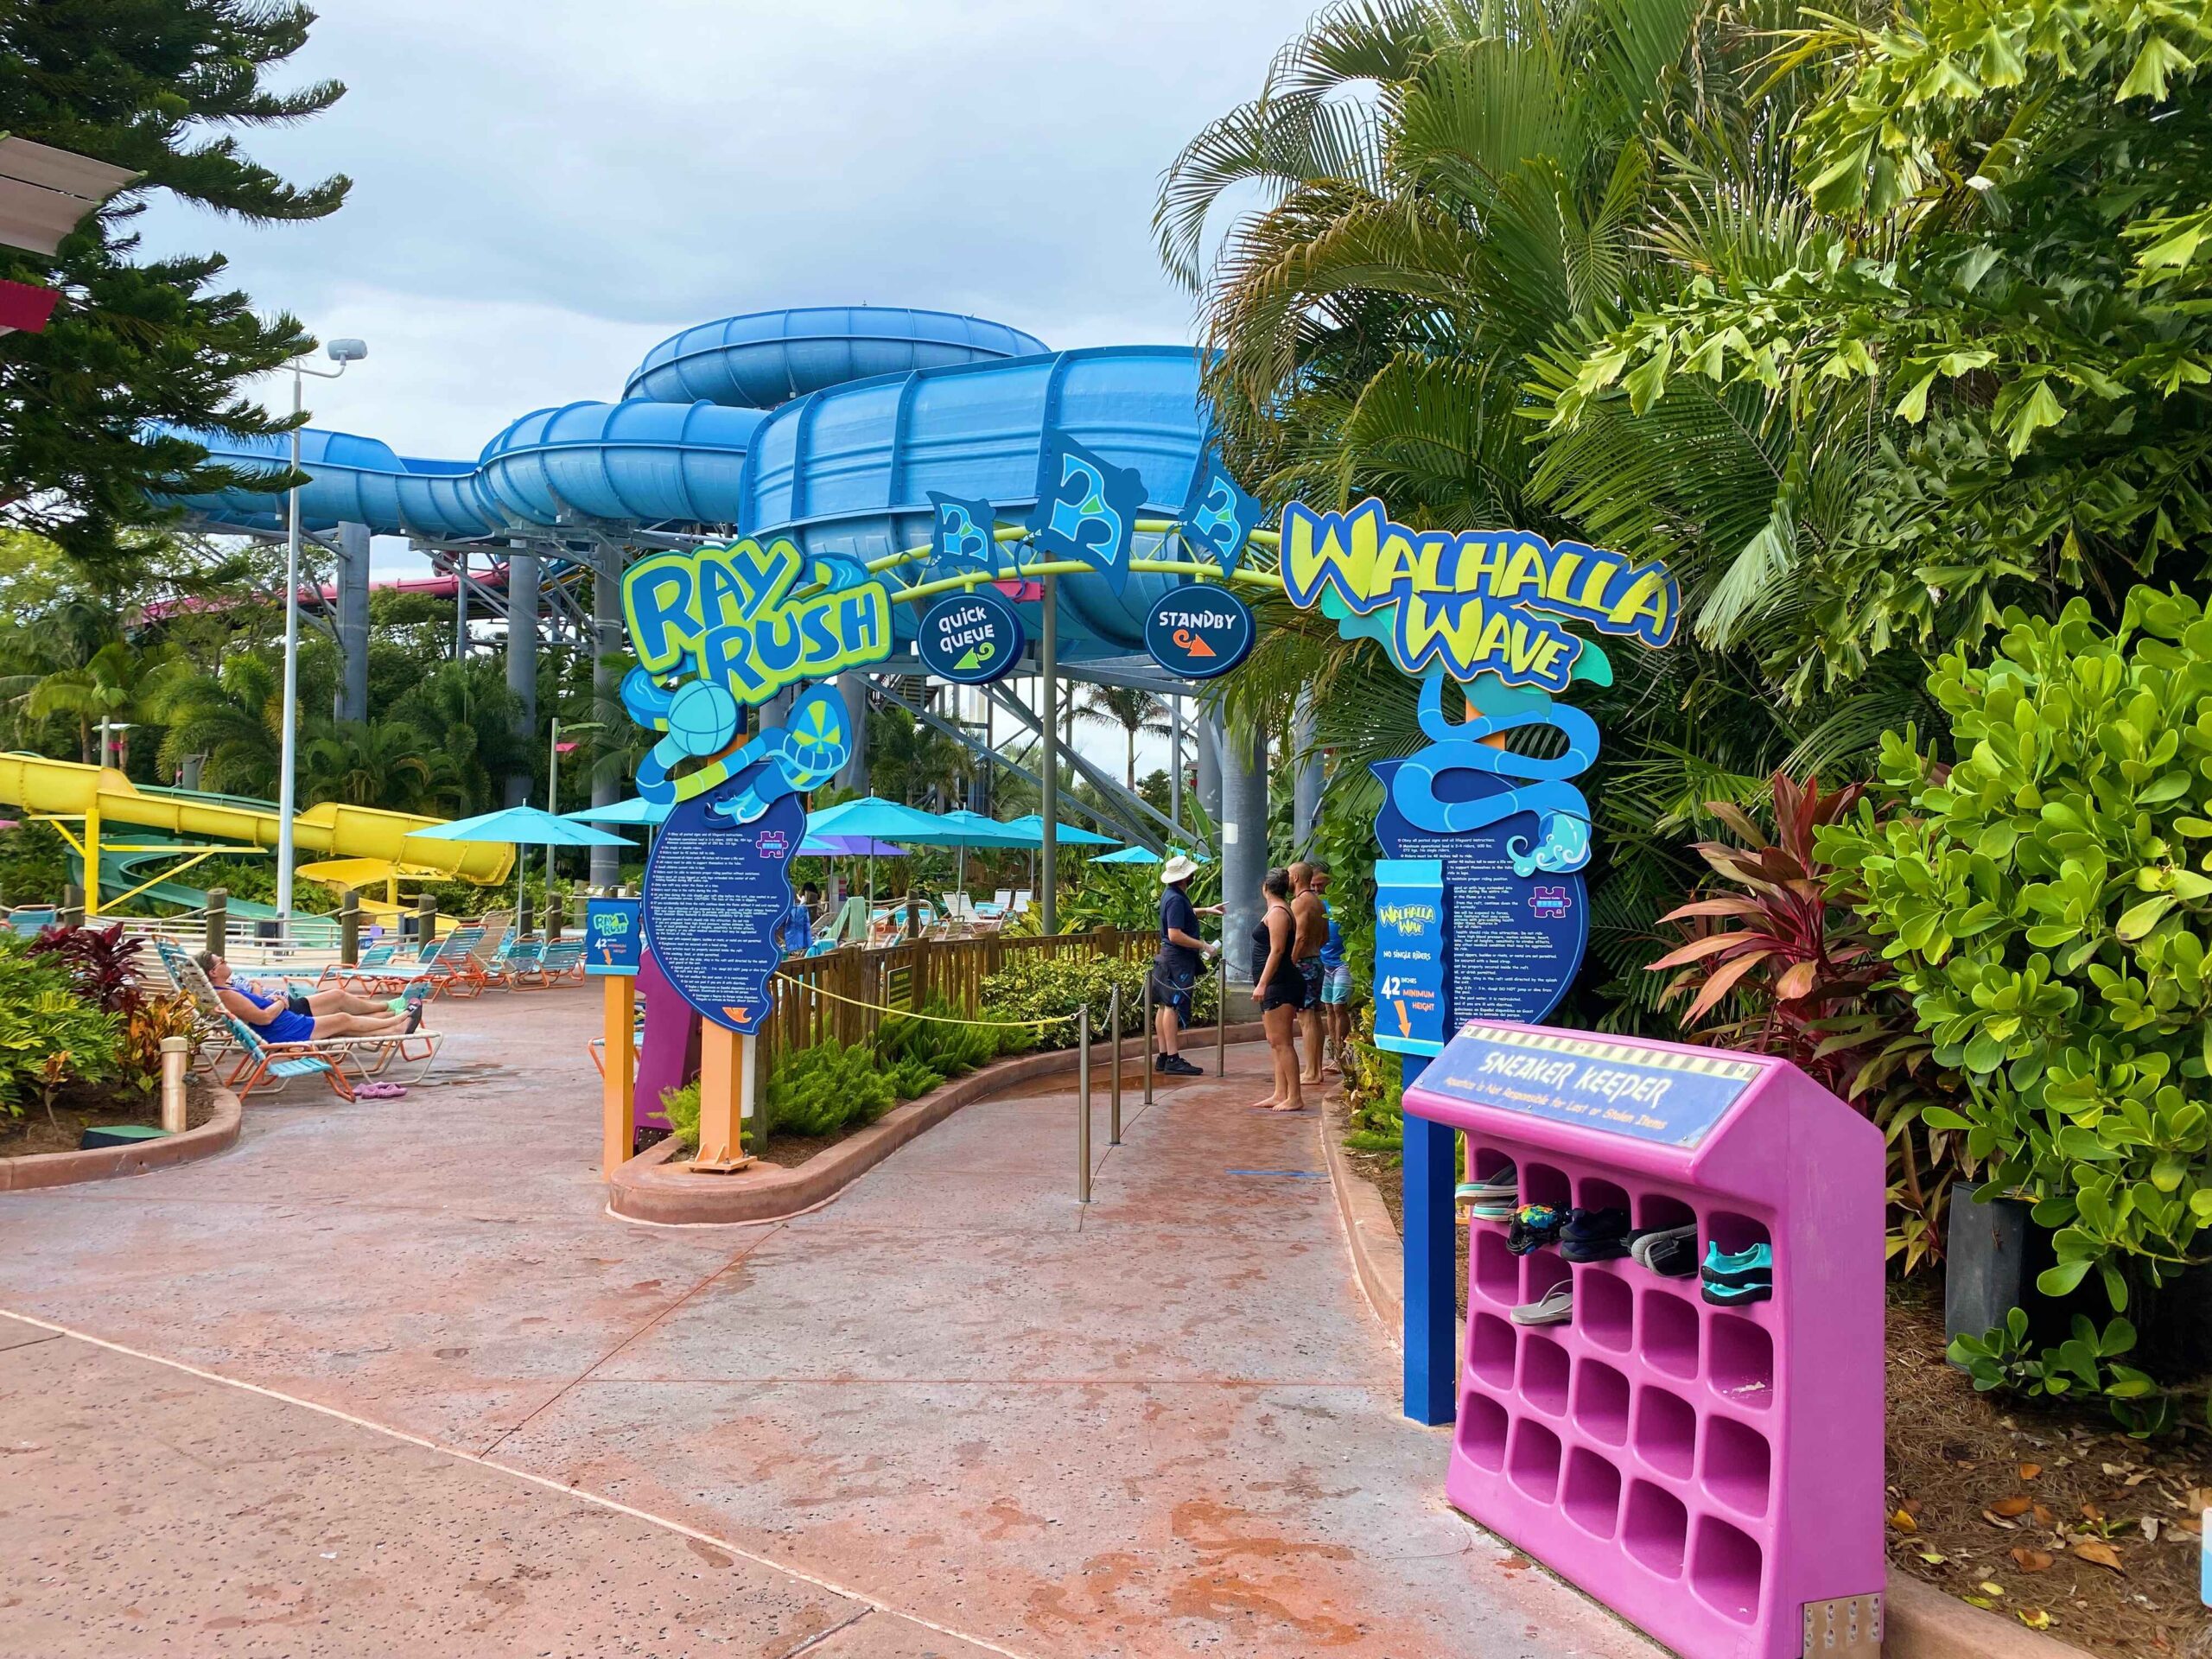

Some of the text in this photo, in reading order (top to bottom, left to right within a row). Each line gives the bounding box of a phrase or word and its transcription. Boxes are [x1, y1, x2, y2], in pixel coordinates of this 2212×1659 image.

[1290, 509, 1668, 636] WALHALLA
[632, 550, 789, 660] RAY
[1159, 610, 1236, 630] STANDBY
[705, 593, 878, 694] RUSH
[939, 624, 995, 654] QUEUE
[1406, 592, 1570, 680] WAVE
[595, 916, 615, 928] RAY
[1380, 905, 1434, 924] WALHALLA
[604, 924, 626, 934] RUSH
[1399, 919, 1423, 934] WAVE
[594, 938, 607, 950] 42
[1393, 950, 1411, 959] SINGLE
[1412, 950, 1431, 960] RIDERS
[1381, 975, 1400, 1000] 42
[1403, 989, 1434, 998] MINIMUM
[1412, 1001, 1434, 1011] HEIGHT
[1478, 1052, 1673, 1109] SNEAKER KEEPER
[1487, 1084, 1503, 1096] Not
[1504, 1089, 1548, 1107] Responsible
[1551, 1096, 1567, 1110] for
[1567, 1101, 1589, 1115] Lost
[1590, 1107, 1600, 1116] or
[1602, 1107, 1634, 1123] Stolen
[1635, 1113, 1668, 1130] Items
